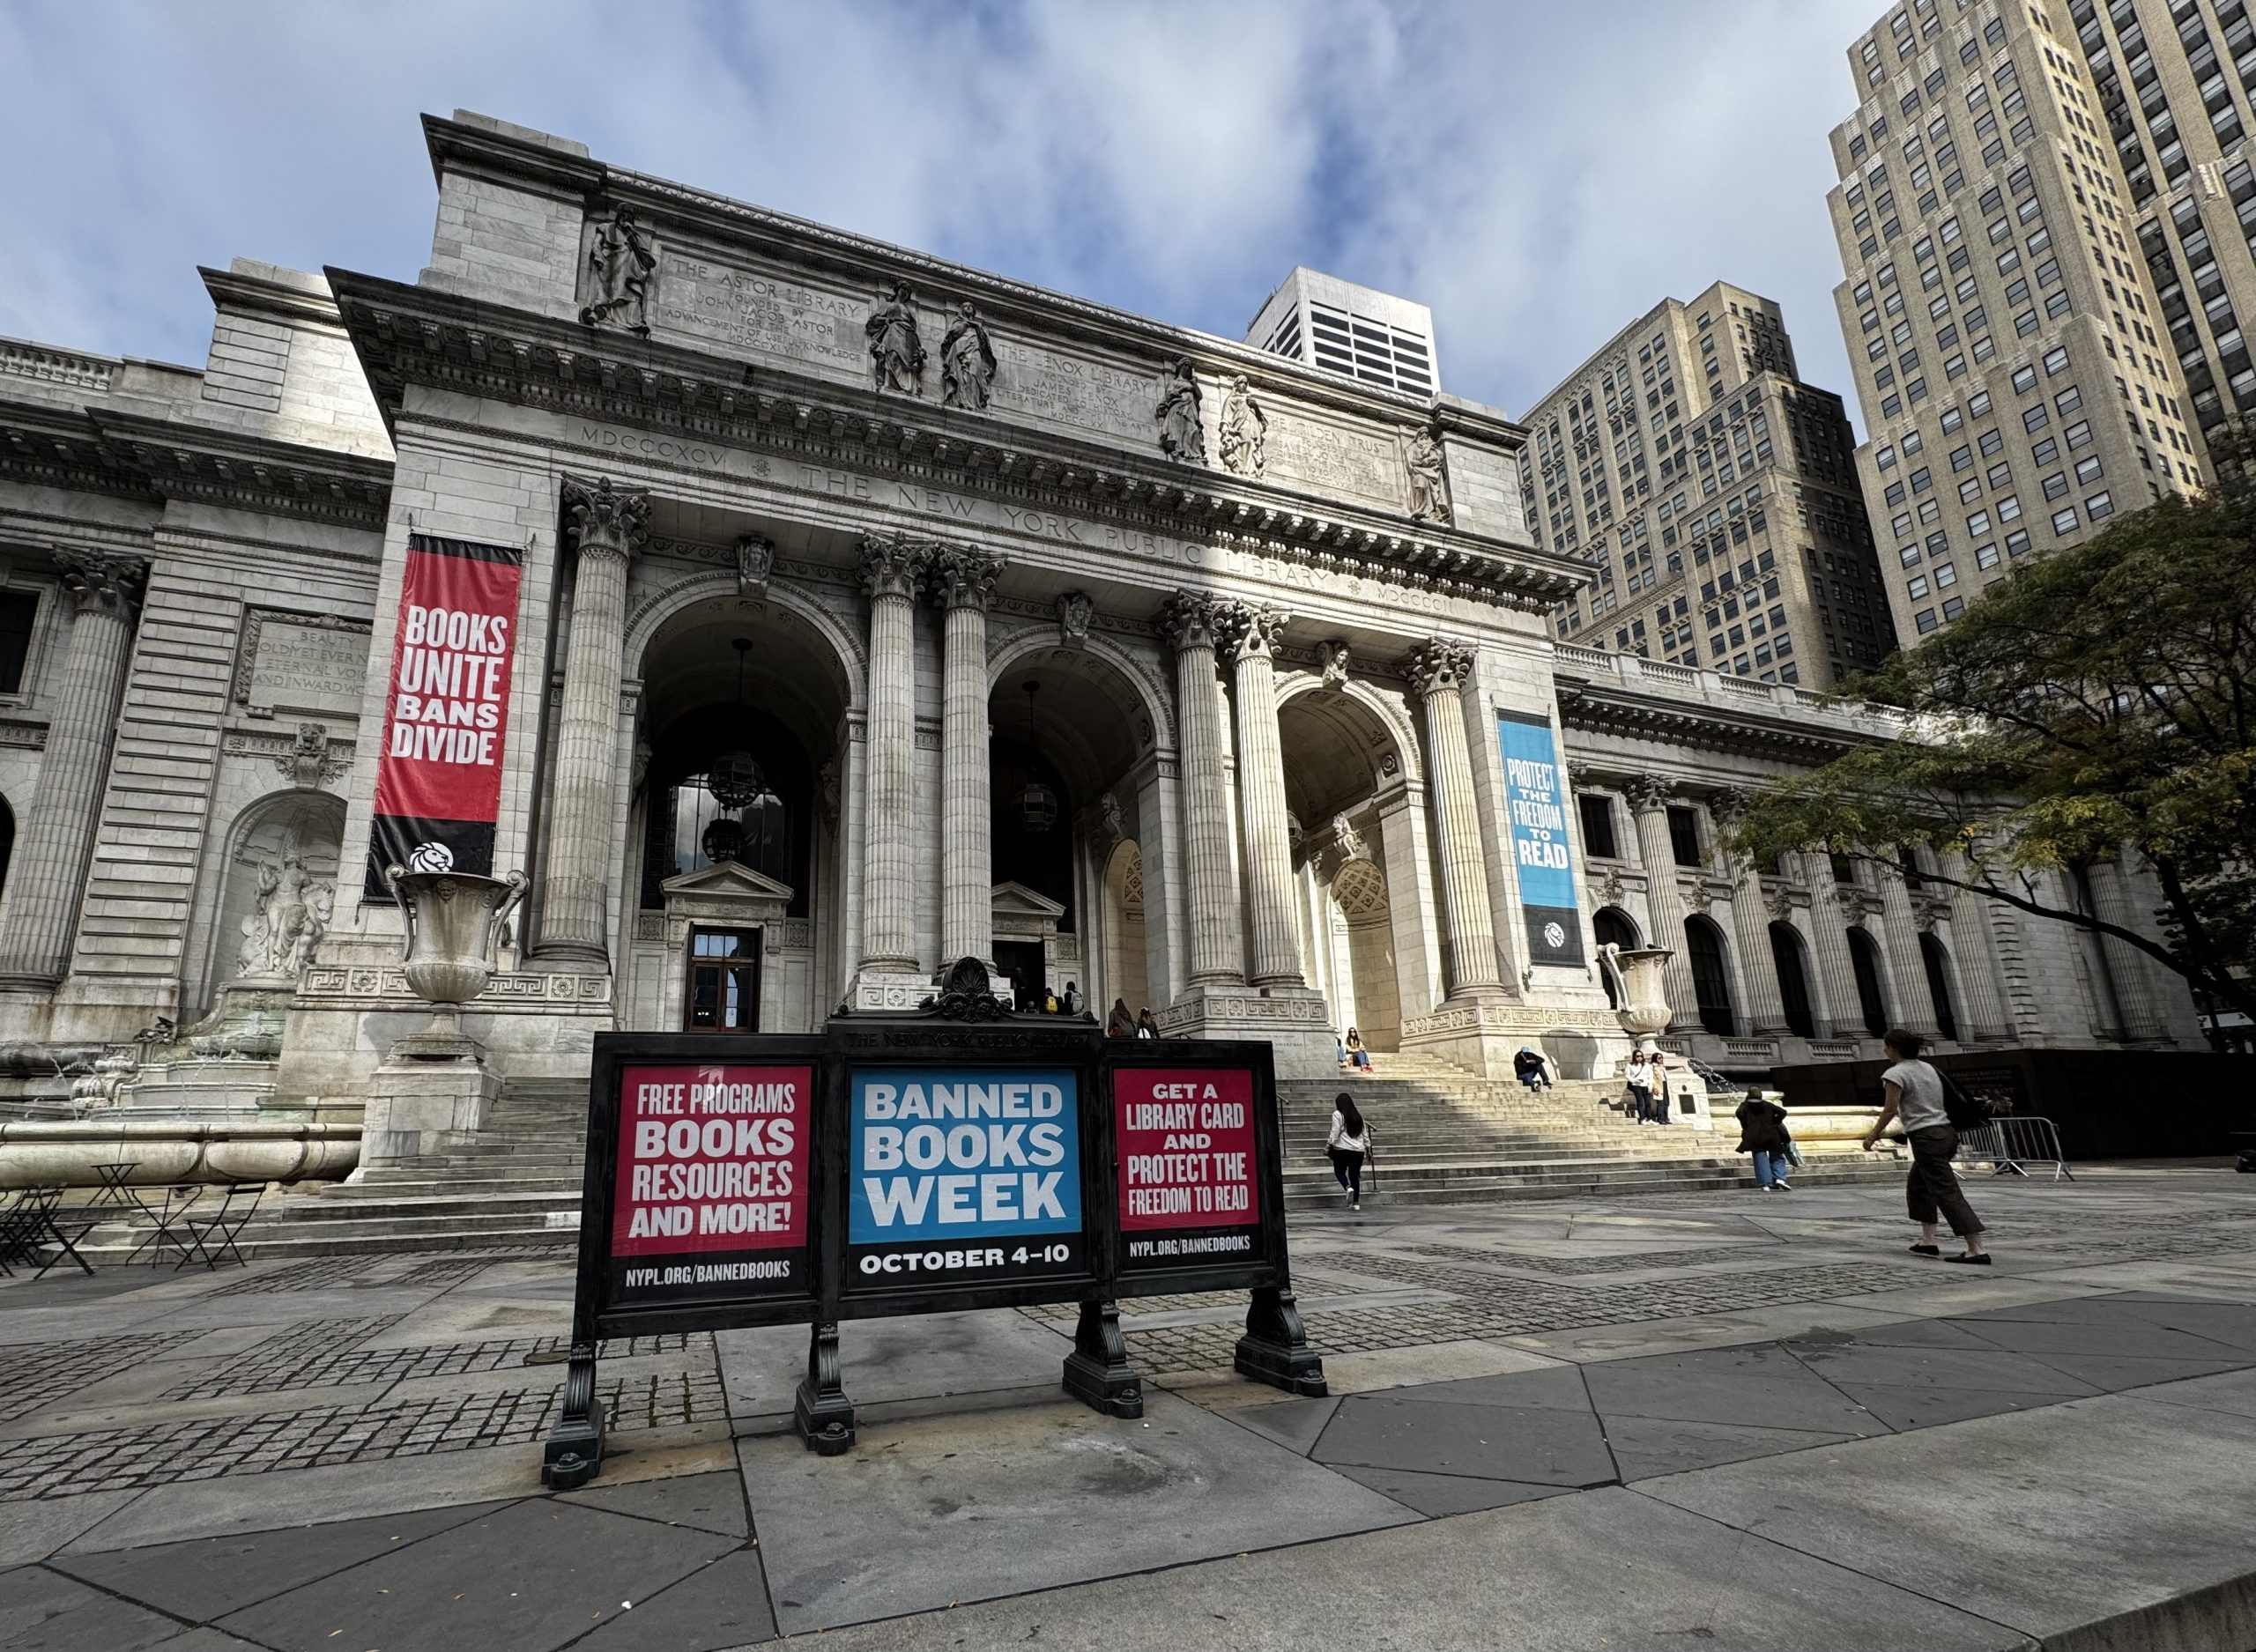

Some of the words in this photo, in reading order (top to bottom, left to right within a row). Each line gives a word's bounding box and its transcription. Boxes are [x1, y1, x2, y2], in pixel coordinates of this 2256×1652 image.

[673, 259, 708, 279] THE
[720, 273, 776, 298] ASTOR
[787, 289, 858, 317] LIBRARY
[696, 295, 734, 311] JOHN
[741, 305, 784, 323] JACOB
[793, 319, 834, 336] ASTOR
[729, 292, 780, 312] FOUNDED
[792, 308, 805, 318] BY
[666, 309, 745, 332] ADVANCEMENT
[747, 328, 761, 337] OF
[766, 332, 800, 348] USEFUL
[803, 341, 861, 362] KNOWLEDGE
[740, 315, 762, 328] FOR
[768, 322, 790, 335] THE
[998, 344, 1028, 362] THE
[1091, 367, 1151, 394] LIBRARY
[997, 389, 1055, 410] LITERATURE
[1019, 385, 1069, 403] DEDICATED
[1033, 379, 1072, 396] JAMES
[1349, 435, 1386, 454] TRUST
[581, 426, 724, 465] MDCCCXCV
[800, 466, 872, 499] THE
[897, 485, 976, 517] NEW
[1003, 507, 1081, 541] YORK
[1105, 528, 1201, 563] PUBLIC
[1226, 552, 1329, 589] LIBRARY
[301, 632, 356, 648] BEAUTY
[405, 604, 508, 655] BOOKS
[260, 642, 289, 655] OLD
[291, 645, 317, 657] YET
[321, 649, 352, 663] EVER
[253, 673, 284, 685] AND
[288, 677, 342, 693] INWARD
[266, 658, 331, 676] ETERNAL
[337, 667, 367, 679] VOIC
[400, 646, 504, 701] UNITE
[395, 693, 499, 729] BANS
[390, 722, 497, 766] DIVIDE
[1506, 758, 1555, 792] PROTECT
[1518, 789, 1551, 803] THE
[1512, 799, 1562, 831] FREEDOM
[1529, 828, 1551, 841] TO
[1518, 839, 1569, 870] READ
[845, 1033, 879, 1048] THE
[884, 1033, 922, 1048] NEW
[928, 1033, 971, 1048] YORK
[636, 1084, 686, 1115] FREE
[689, 1083, 796, 1115] PROGRAMS
[865, 1083, 1063, 1120] BANNED
[1153, 1084, 1197, 1100] GET
[1202, 1084, 1218, 1099] A
[1125, 1103, 1197, 1130] LIBRARY
[1200, 1102, 1244, 1129] CARD
[634, 1118, 795, 1159] BOOKS
[863, 1122, 1065, 1171] BOOKS
[1163, 1133, 1212, 1150] AND
[631, 1160, 793, 1202] RESOURCES
[1127, 1153, 1209, 1184] PROTECT
[1213, 1152, 1248, 1181] THE
[863, 1171, 1067, 1227] WEEK
[1128, 1187, 1191, 1216] FREEDOM
[1194, 1186, 1212, 1212] TO
[1215, 1185, 1249, 1211] READ
[628, 1205, 694, 1239] AND
[699, 1202, 791, 1235] MORE!
[859, 1248, 1005, 1274] OCTOBER
[1130, 1235, 1250, 1257] NYPL.ORG/BANNEDBOOKS
[626, 1260, 790, 1287] NYPL.ORG/BANNEDBOOKS
